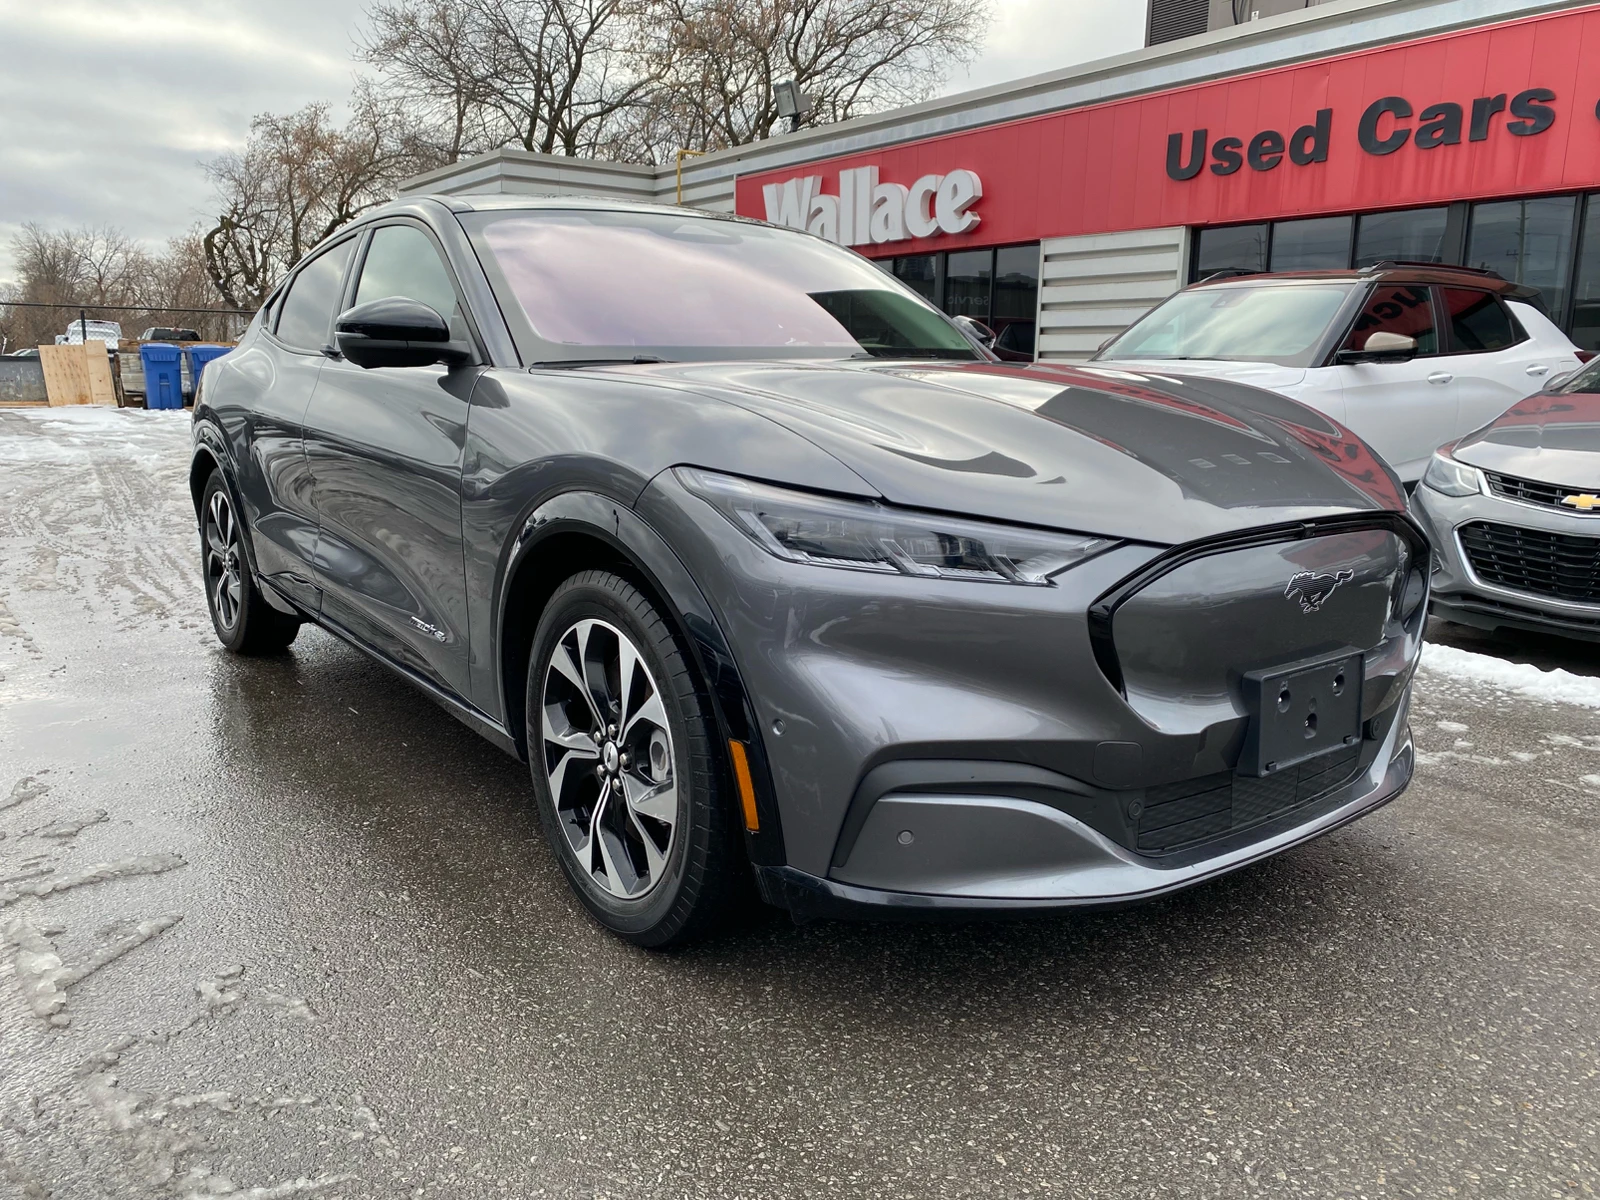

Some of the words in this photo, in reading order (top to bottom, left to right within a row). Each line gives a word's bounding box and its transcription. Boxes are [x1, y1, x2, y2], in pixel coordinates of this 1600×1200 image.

[1165, 107, 1333, 181] Used
[1357, 87, 1556, 156] Cars
[762, 165, 983, 246] Wallace
